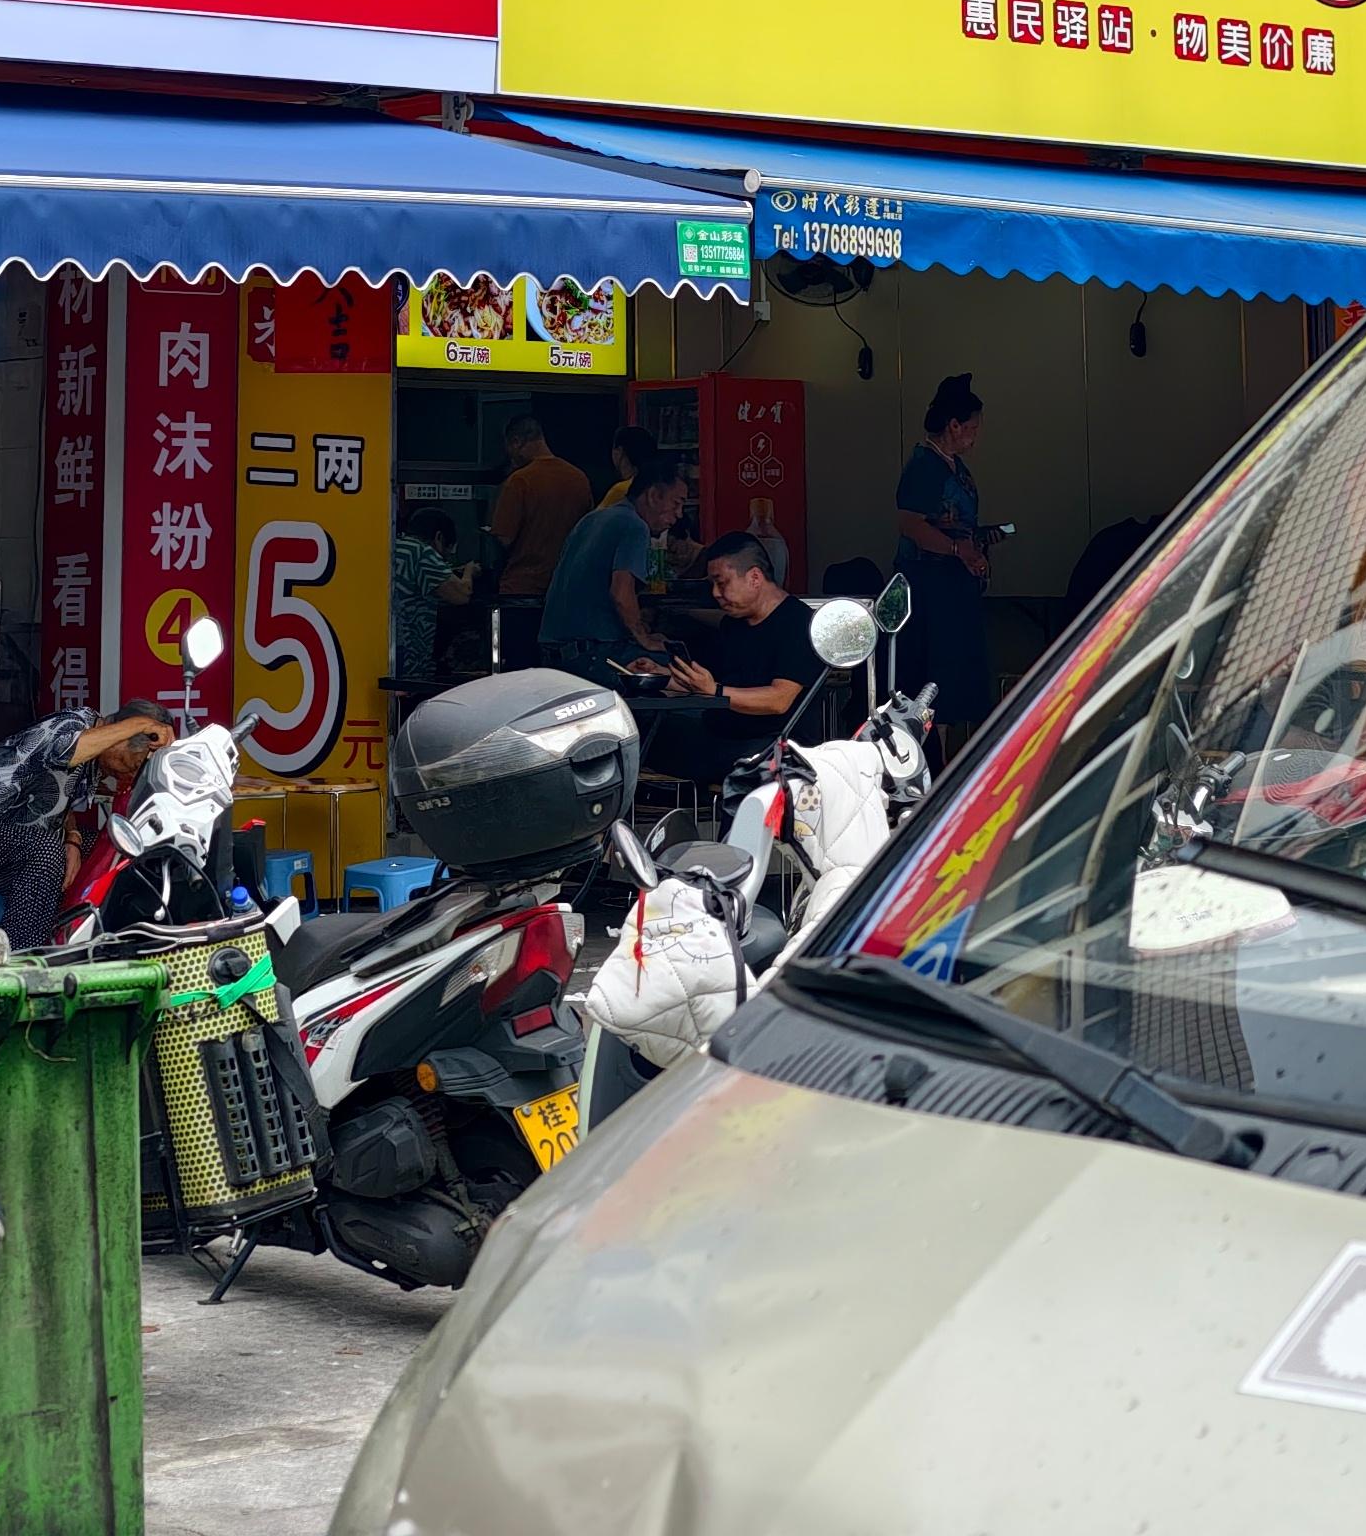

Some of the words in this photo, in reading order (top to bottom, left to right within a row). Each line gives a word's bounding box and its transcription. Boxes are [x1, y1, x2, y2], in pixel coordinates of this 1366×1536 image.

[773, 223, 798, 250] Tel:
[803, 221, 902, 259] 13768899698
[445, 340, 491, 365] 6元/碗
[549, 344, 593, 369] 5元/碗
[246, 431, 365, 495] 二两
[554, 698, 597, 720] SHAD
